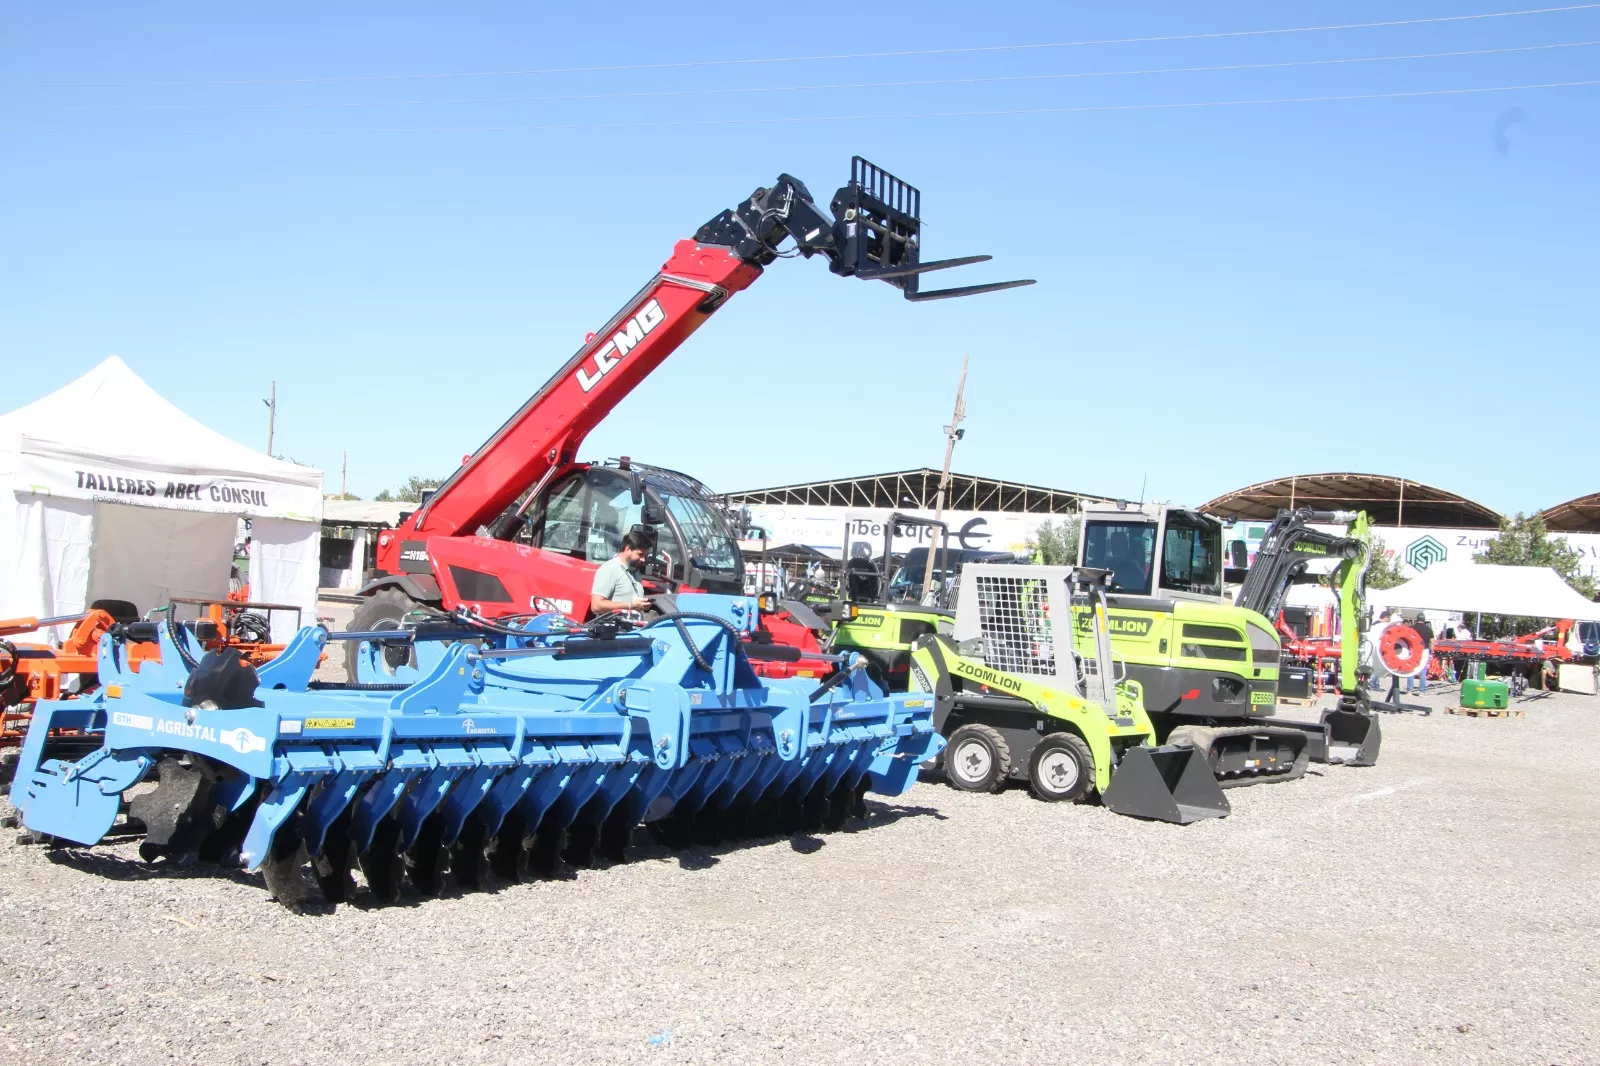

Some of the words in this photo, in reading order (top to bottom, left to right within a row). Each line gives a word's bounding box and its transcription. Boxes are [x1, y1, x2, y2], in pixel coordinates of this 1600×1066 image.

[75, 471, 156, 497] TALLERES
[164, 482, 202, 501] ABEL
[210, 484, 268, 507] CÓNSUL
[1294, 541, 1327, 555] ZOOMLION
[1081, 617, 1148, 633] ZMLION
[957, 661, 1022, 692] ZOOMLION
[156, 718, 217, 743] AGRISTAL
[469, 727, 497, 735] AGRISTAL
